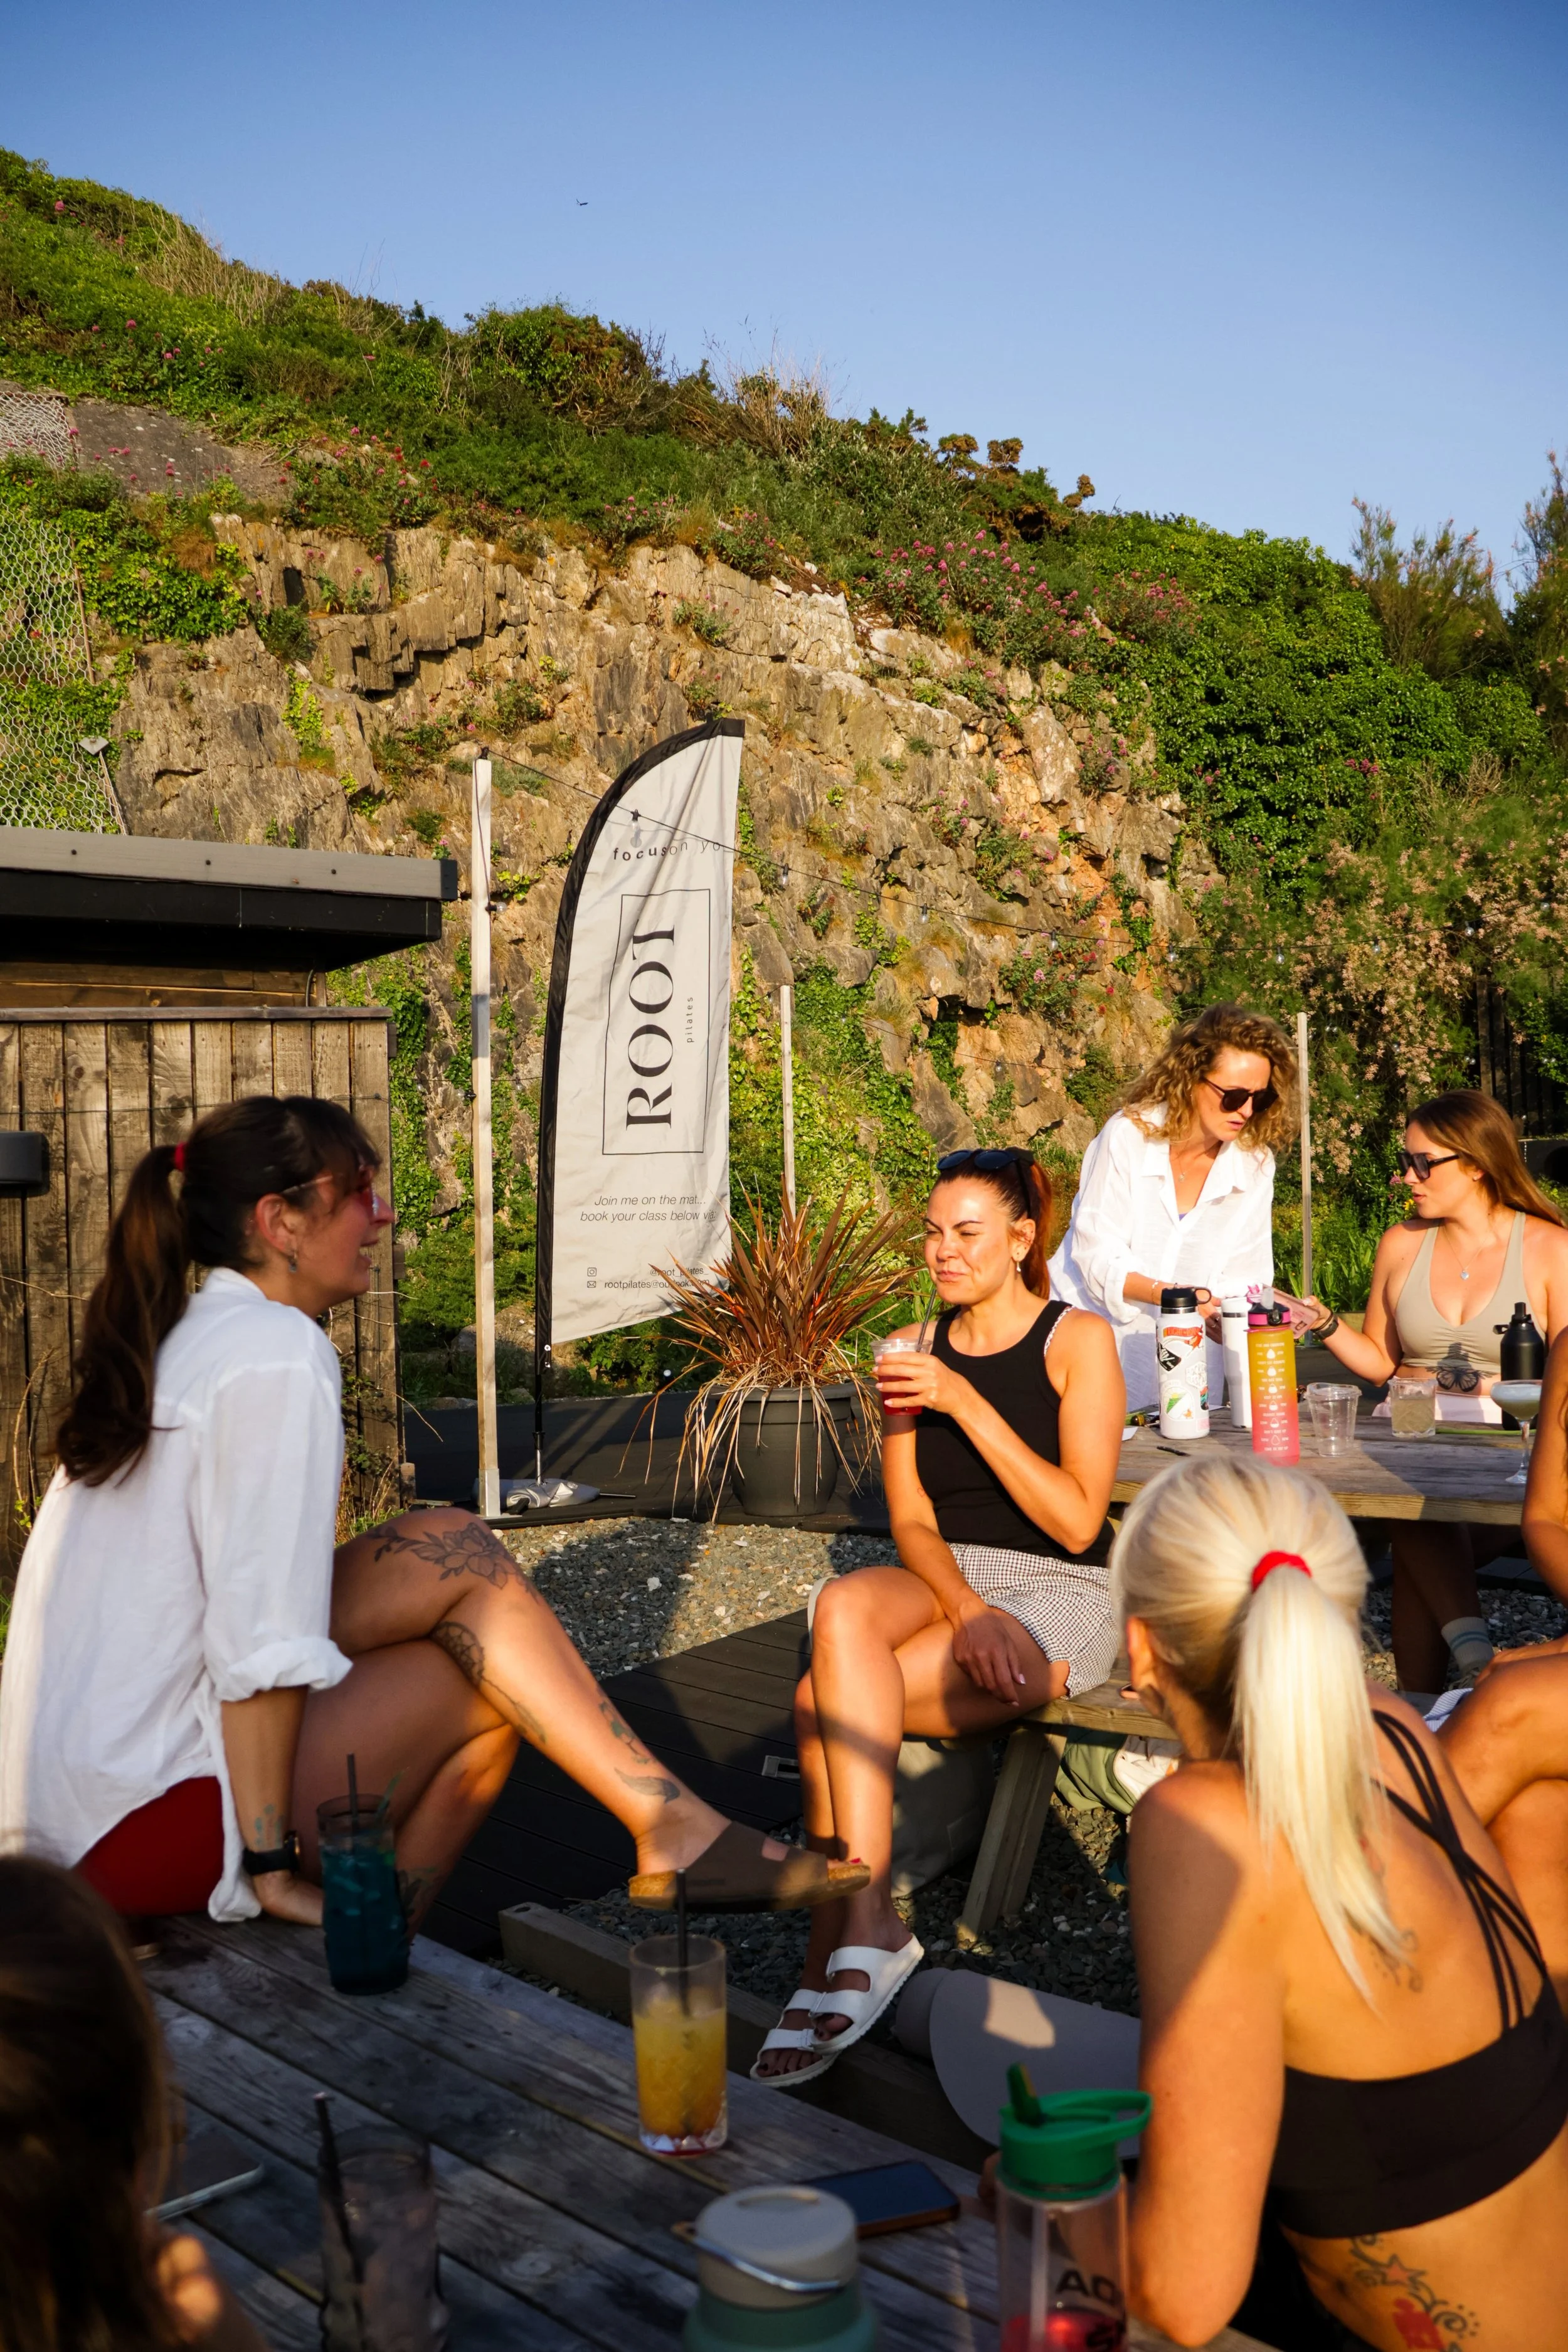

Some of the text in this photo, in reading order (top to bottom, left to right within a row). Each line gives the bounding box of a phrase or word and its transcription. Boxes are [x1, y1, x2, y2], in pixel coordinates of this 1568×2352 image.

[613, 845, 667, 861] focus
[669, 841, 688, 856] on
[626, 919, 674, 1131] ROOT
[685, 997, 695, 1043] pilates
[594, 1195, 706, 1206] Join me on the mat...
[580, 1211, 608, 1221] book
[611, 1212, 636, 1223] your
[638, 1210, 667, 1221] class
[670, 1210, 700, 1221] below
